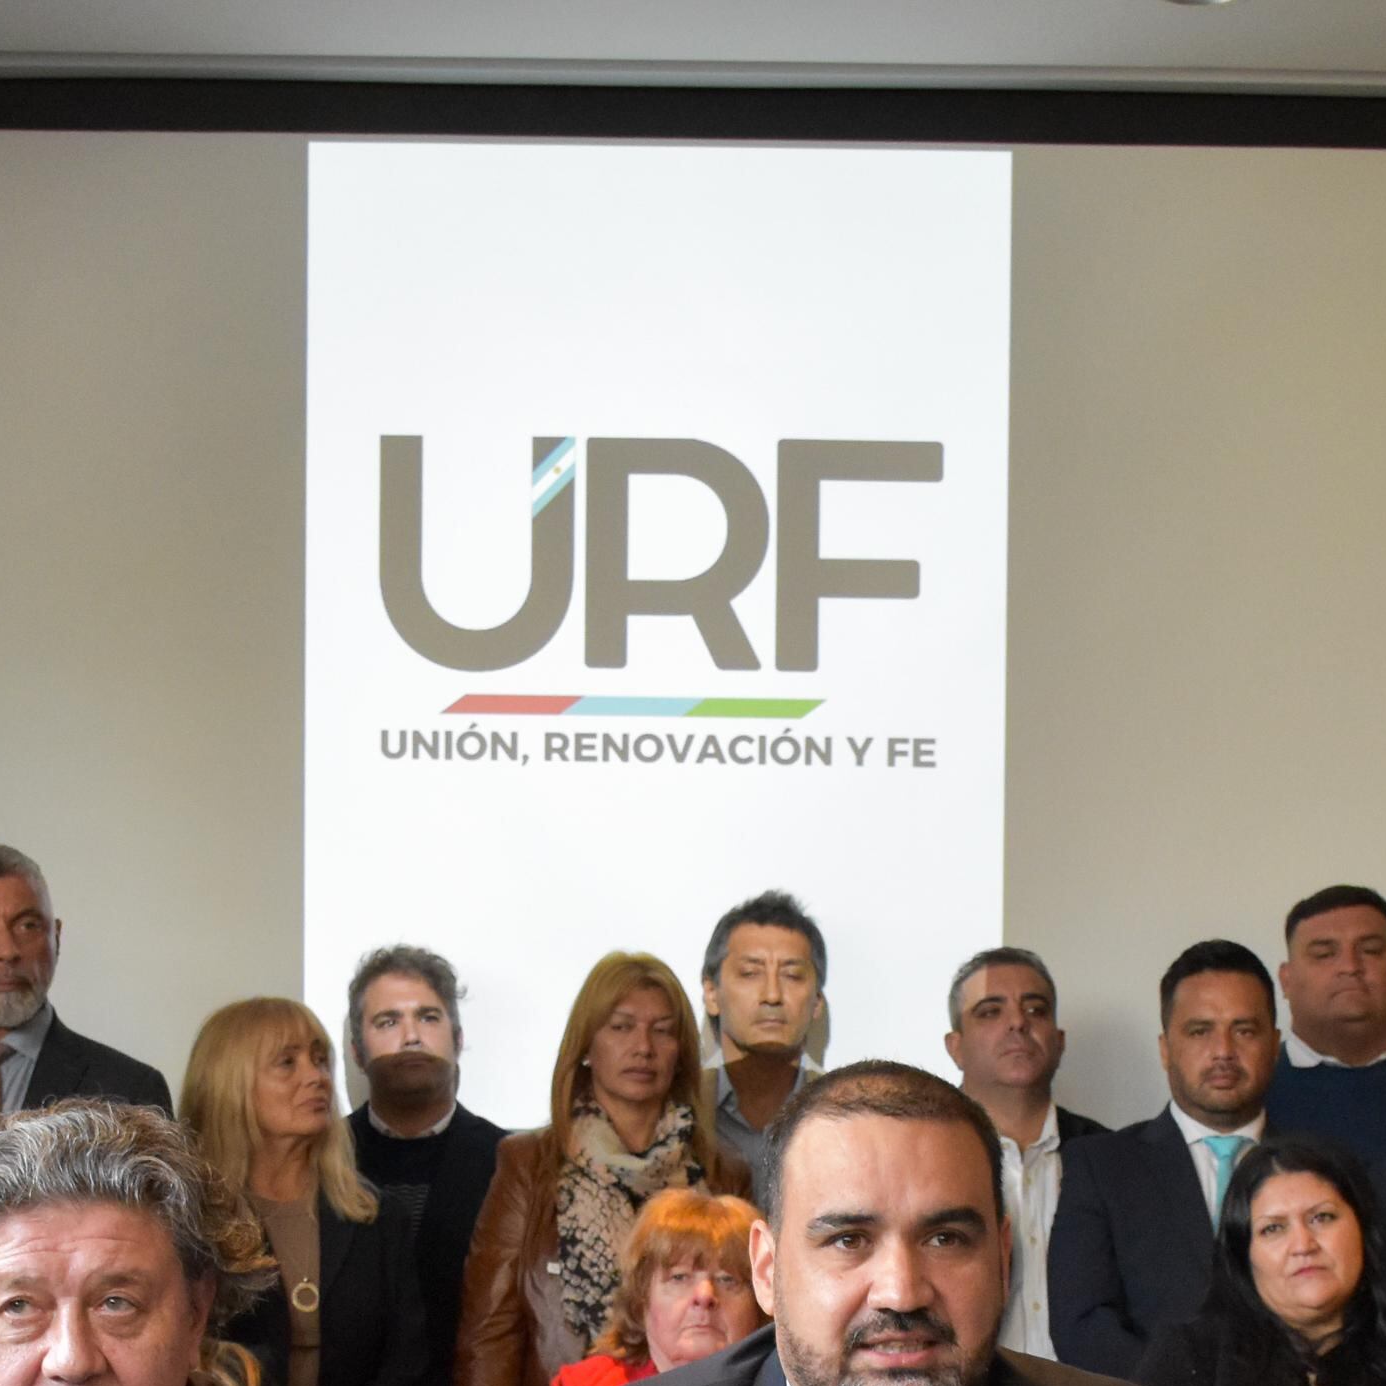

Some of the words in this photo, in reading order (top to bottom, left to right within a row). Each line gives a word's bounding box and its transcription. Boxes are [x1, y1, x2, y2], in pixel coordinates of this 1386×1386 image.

[378, 434, 945, 674] URF
[379, 722, 530, 766] UNIÓN,
[544, 727, 834, 767] RENOVACIÓN
[846, 736, 875, 767] Y
[886, 737, 937, 769] FE
